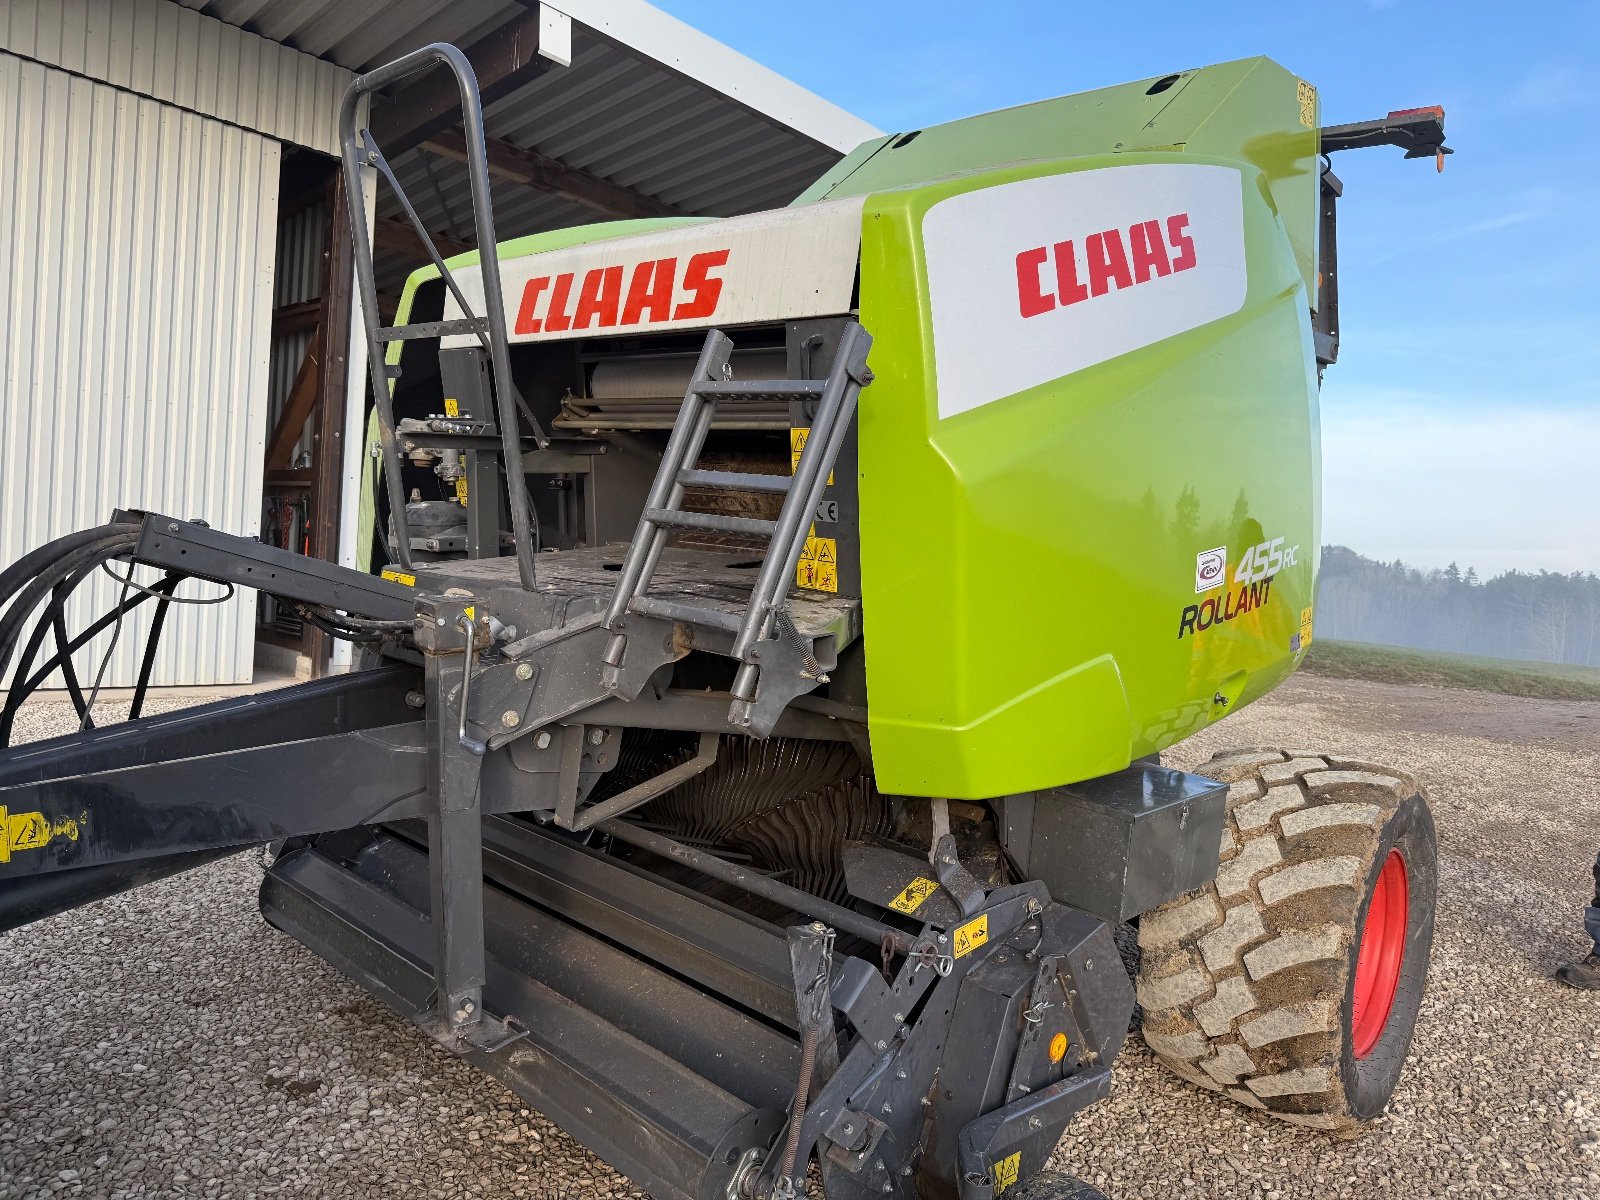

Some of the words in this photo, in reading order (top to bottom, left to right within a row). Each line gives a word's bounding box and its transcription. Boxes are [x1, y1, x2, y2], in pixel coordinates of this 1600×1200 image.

[514, 249, 730, 335] CLAAS
[1015, 213, 1196, 318] CLAAS
[1233, 536, 1285, 585] 455
[1282, 545, 1300, 570] RC
[1178, 575, 1274, 639] ROLLANT
